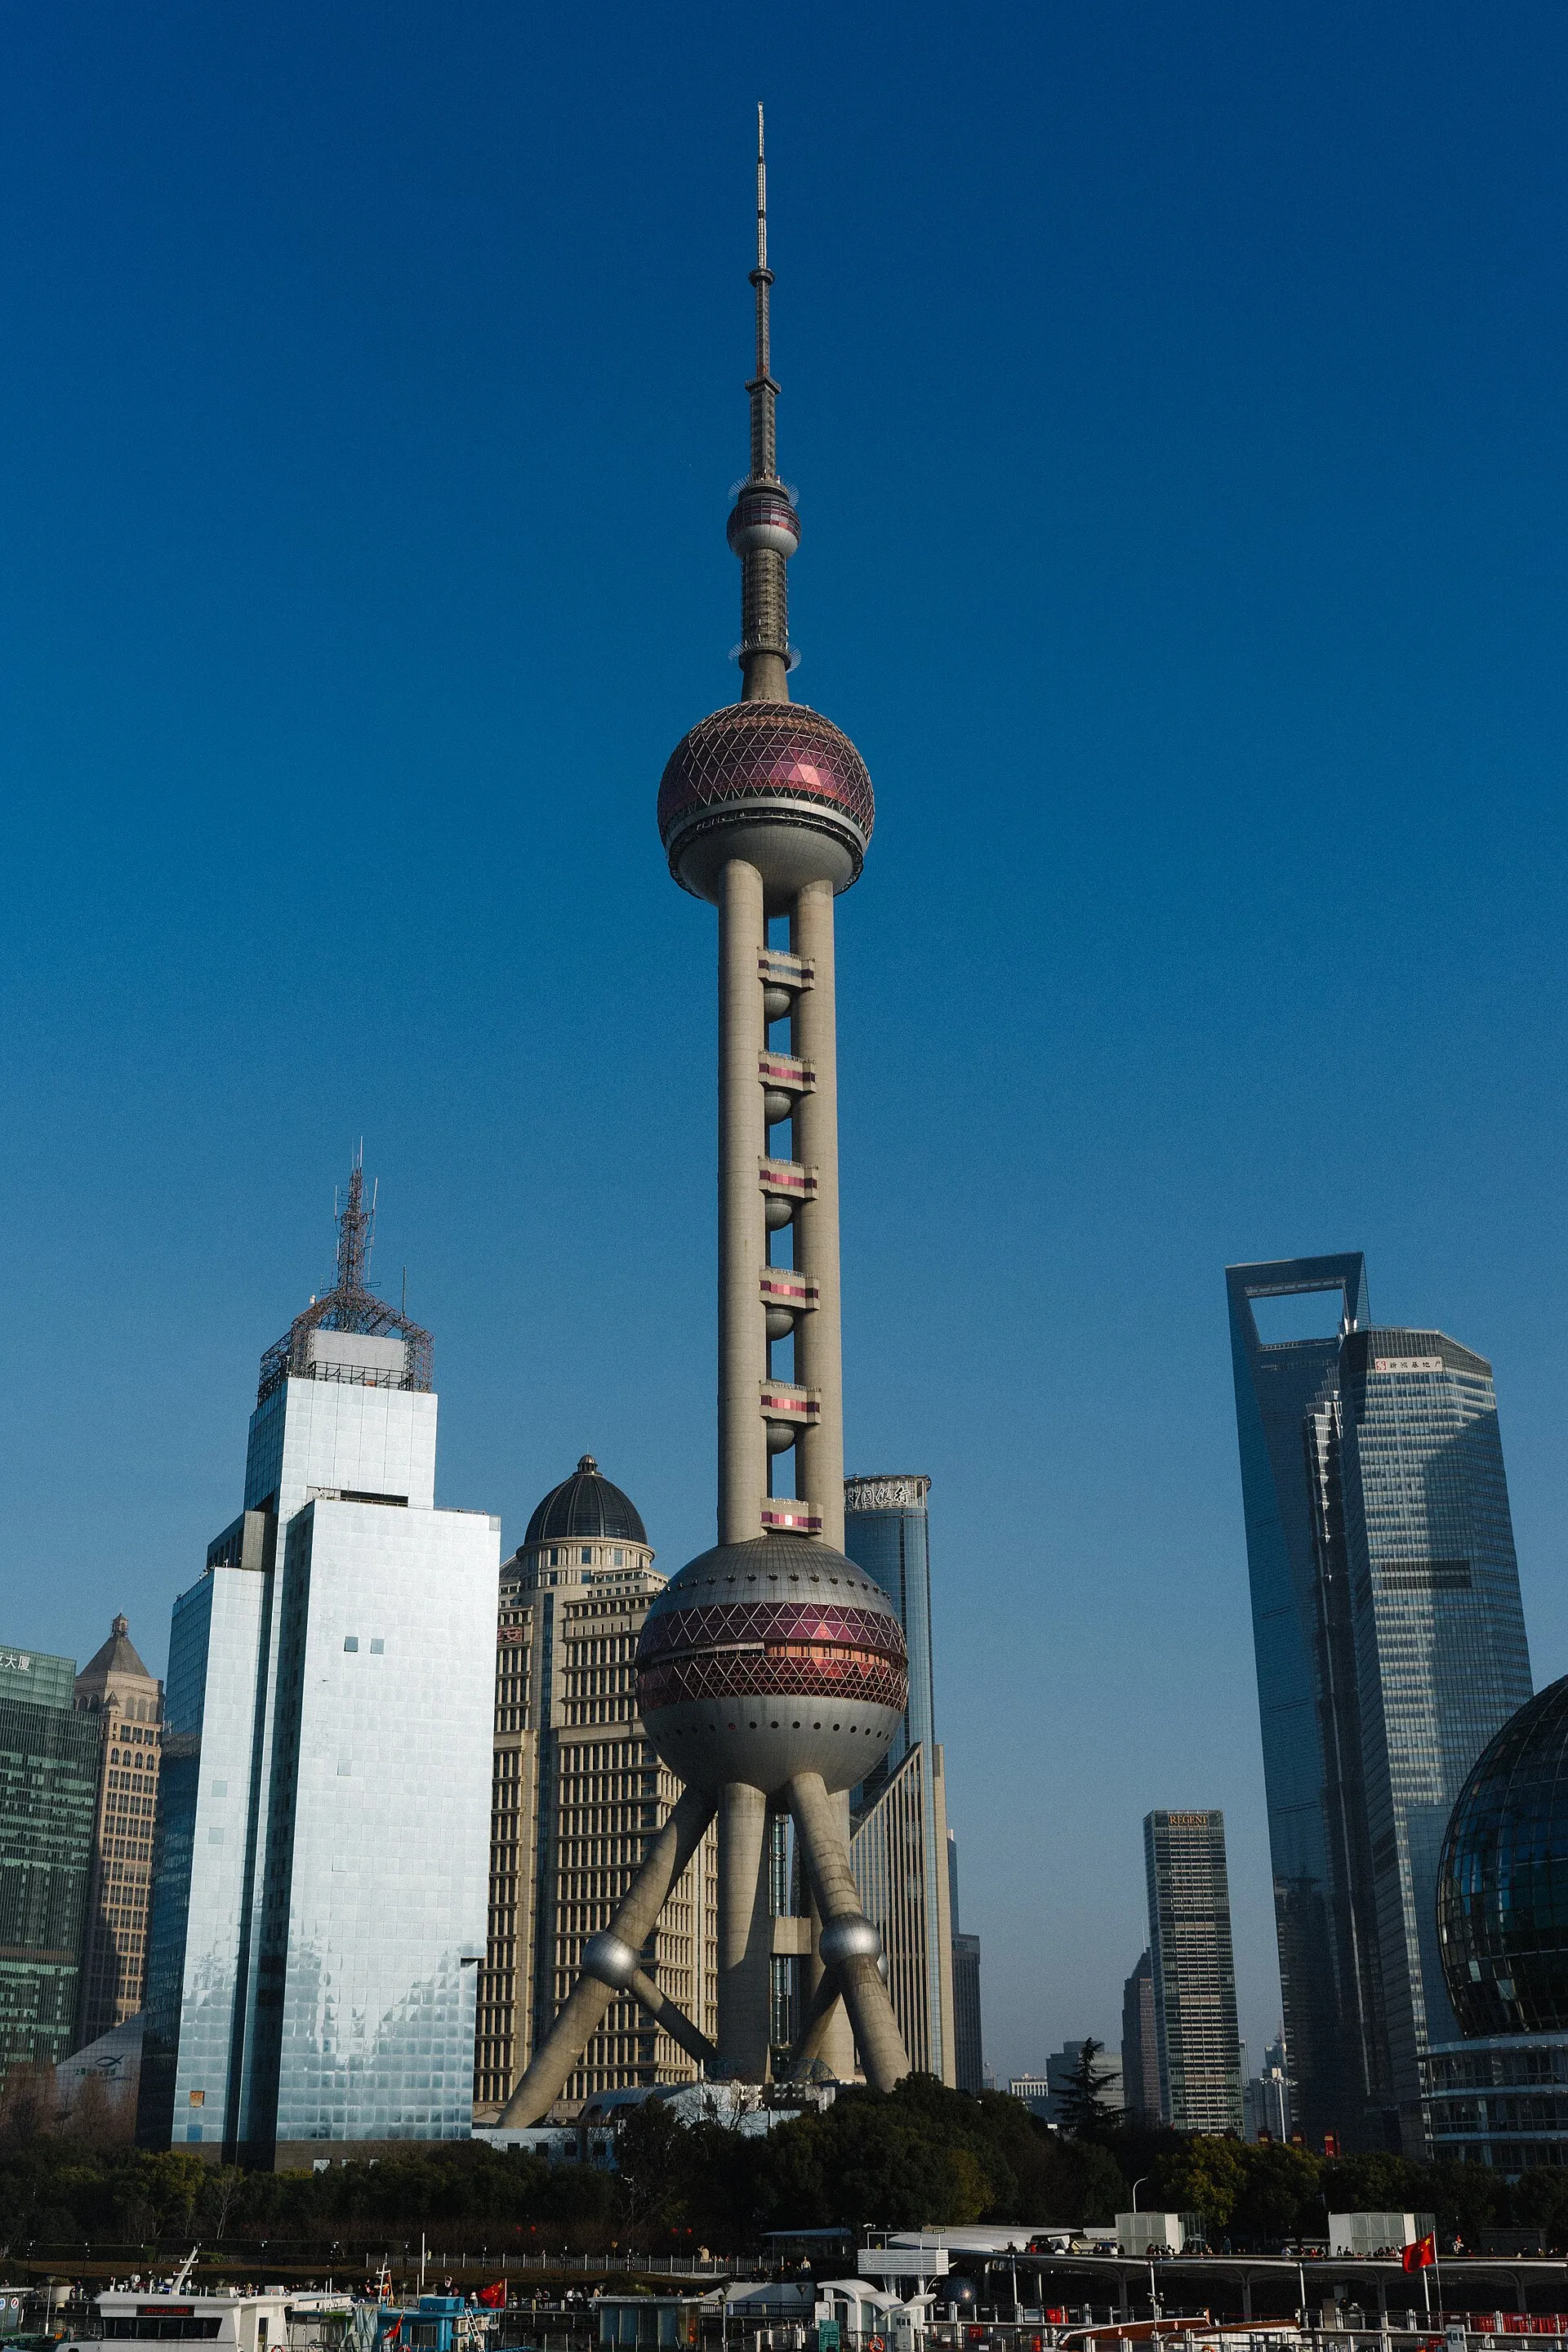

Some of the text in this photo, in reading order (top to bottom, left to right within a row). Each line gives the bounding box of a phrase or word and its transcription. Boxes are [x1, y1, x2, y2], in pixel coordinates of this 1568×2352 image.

[848, 1486, 910, 1508] 中國銀行
[1169, 1815, 1208, 1824] REGENT
